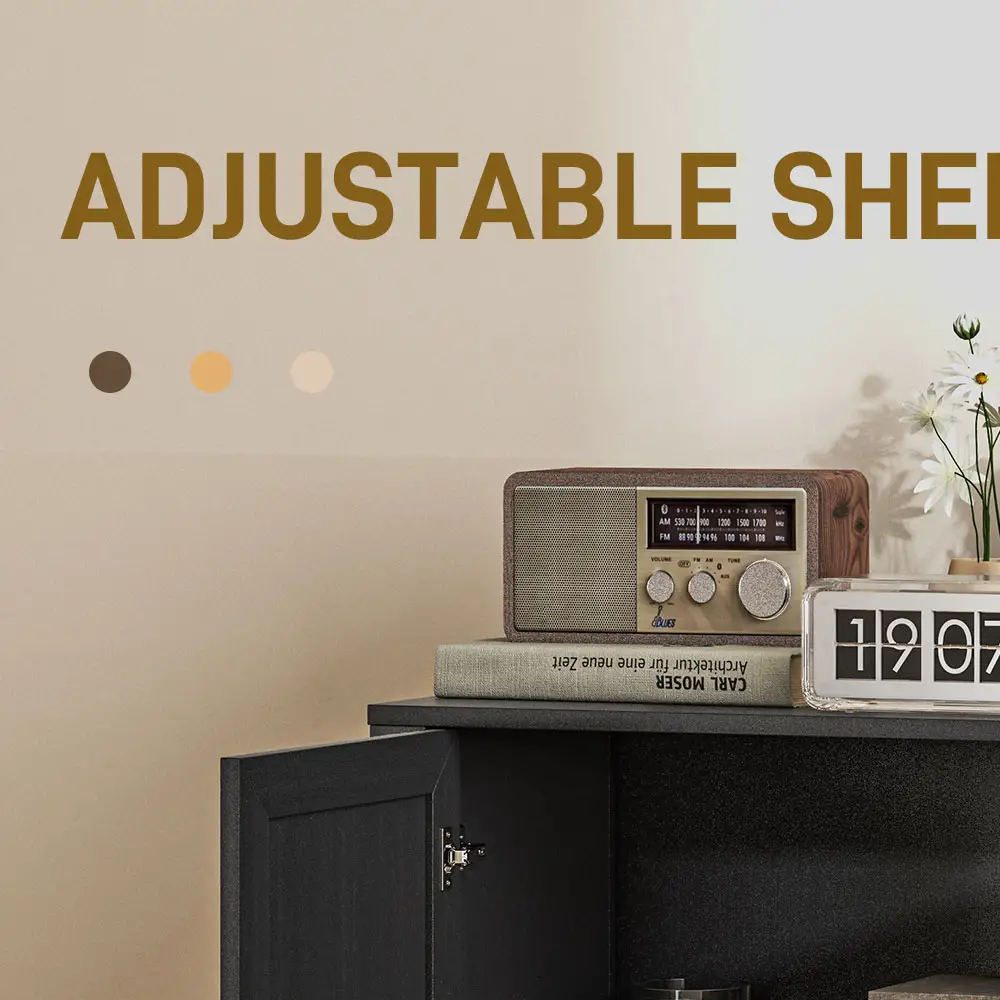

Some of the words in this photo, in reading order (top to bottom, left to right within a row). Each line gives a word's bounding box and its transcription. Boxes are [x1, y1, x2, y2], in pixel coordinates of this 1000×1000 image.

[674, 518, 685, 526] 530
[686, 518, 696, 526] 700
[699, 518, 709, 526] 900
[718, 518, 731, 526] 1200
[737, 518, 749, 527] 1500
[753, 519, 767, 527] 1700
[686, 533, 694, 541] 90
[702, 533, 710, 541] 94
[710, 533, 718, 541] 96
[724, 534, 735, 542] 100
[739, 534, 750, 542] 104
[755, 534, 766, 542] 108
[552, 656, 577, 671] Zeit
[582, 656, 613, 669] neue
[618, 657, 645, 673] eine
[650, 658, 669, 674] für
[673, 659, 748, 675] Architektur
[656, 675, 705, 691] MOSER
[711, 676, 747, 692] CARL
